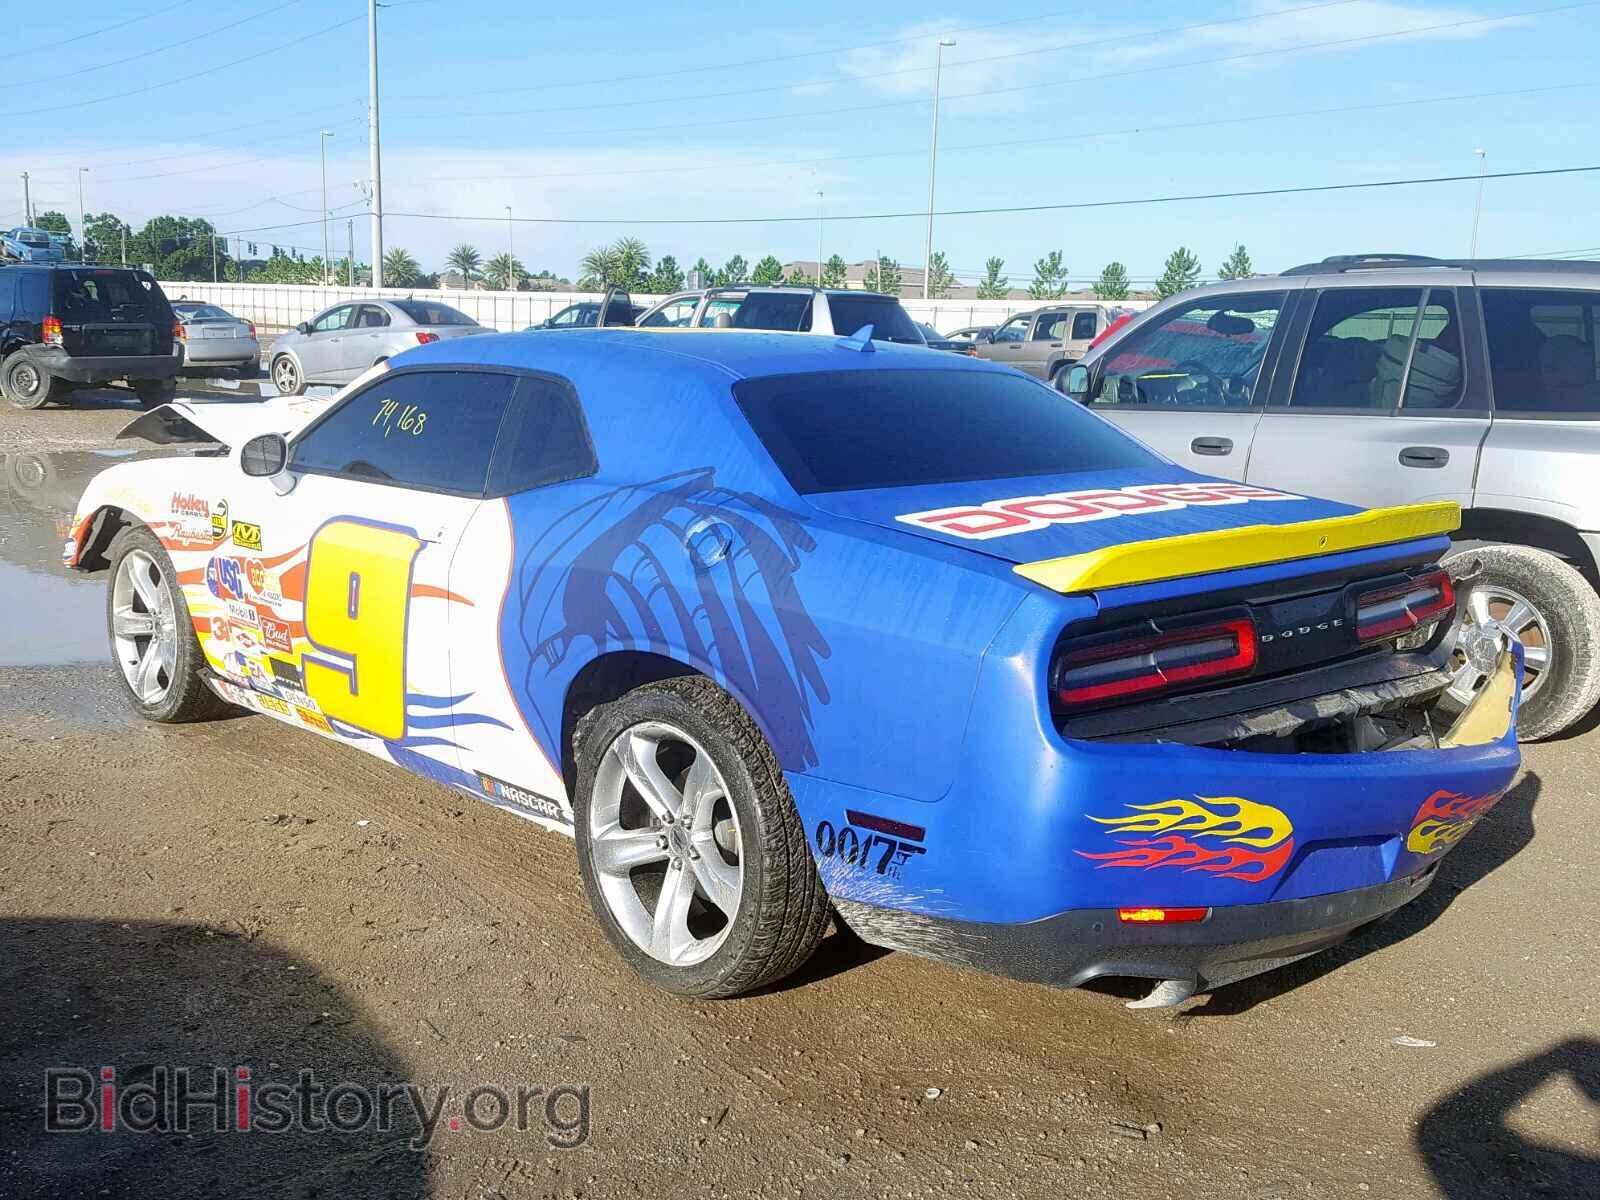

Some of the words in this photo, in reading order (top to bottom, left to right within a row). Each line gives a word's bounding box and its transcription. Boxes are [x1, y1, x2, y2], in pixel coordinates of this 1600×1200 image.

[372, 399, 427, 438] 74,168
[171, 491, 209, 518] Holley
[908, 484, 1296, 537] DODGE
[264, 621, 289, 641] Bud
[303, 514, 428, 742] 9
[1261, 619, 1343, 643] DODGE
[501, 783, 563, 819] NASCAR
